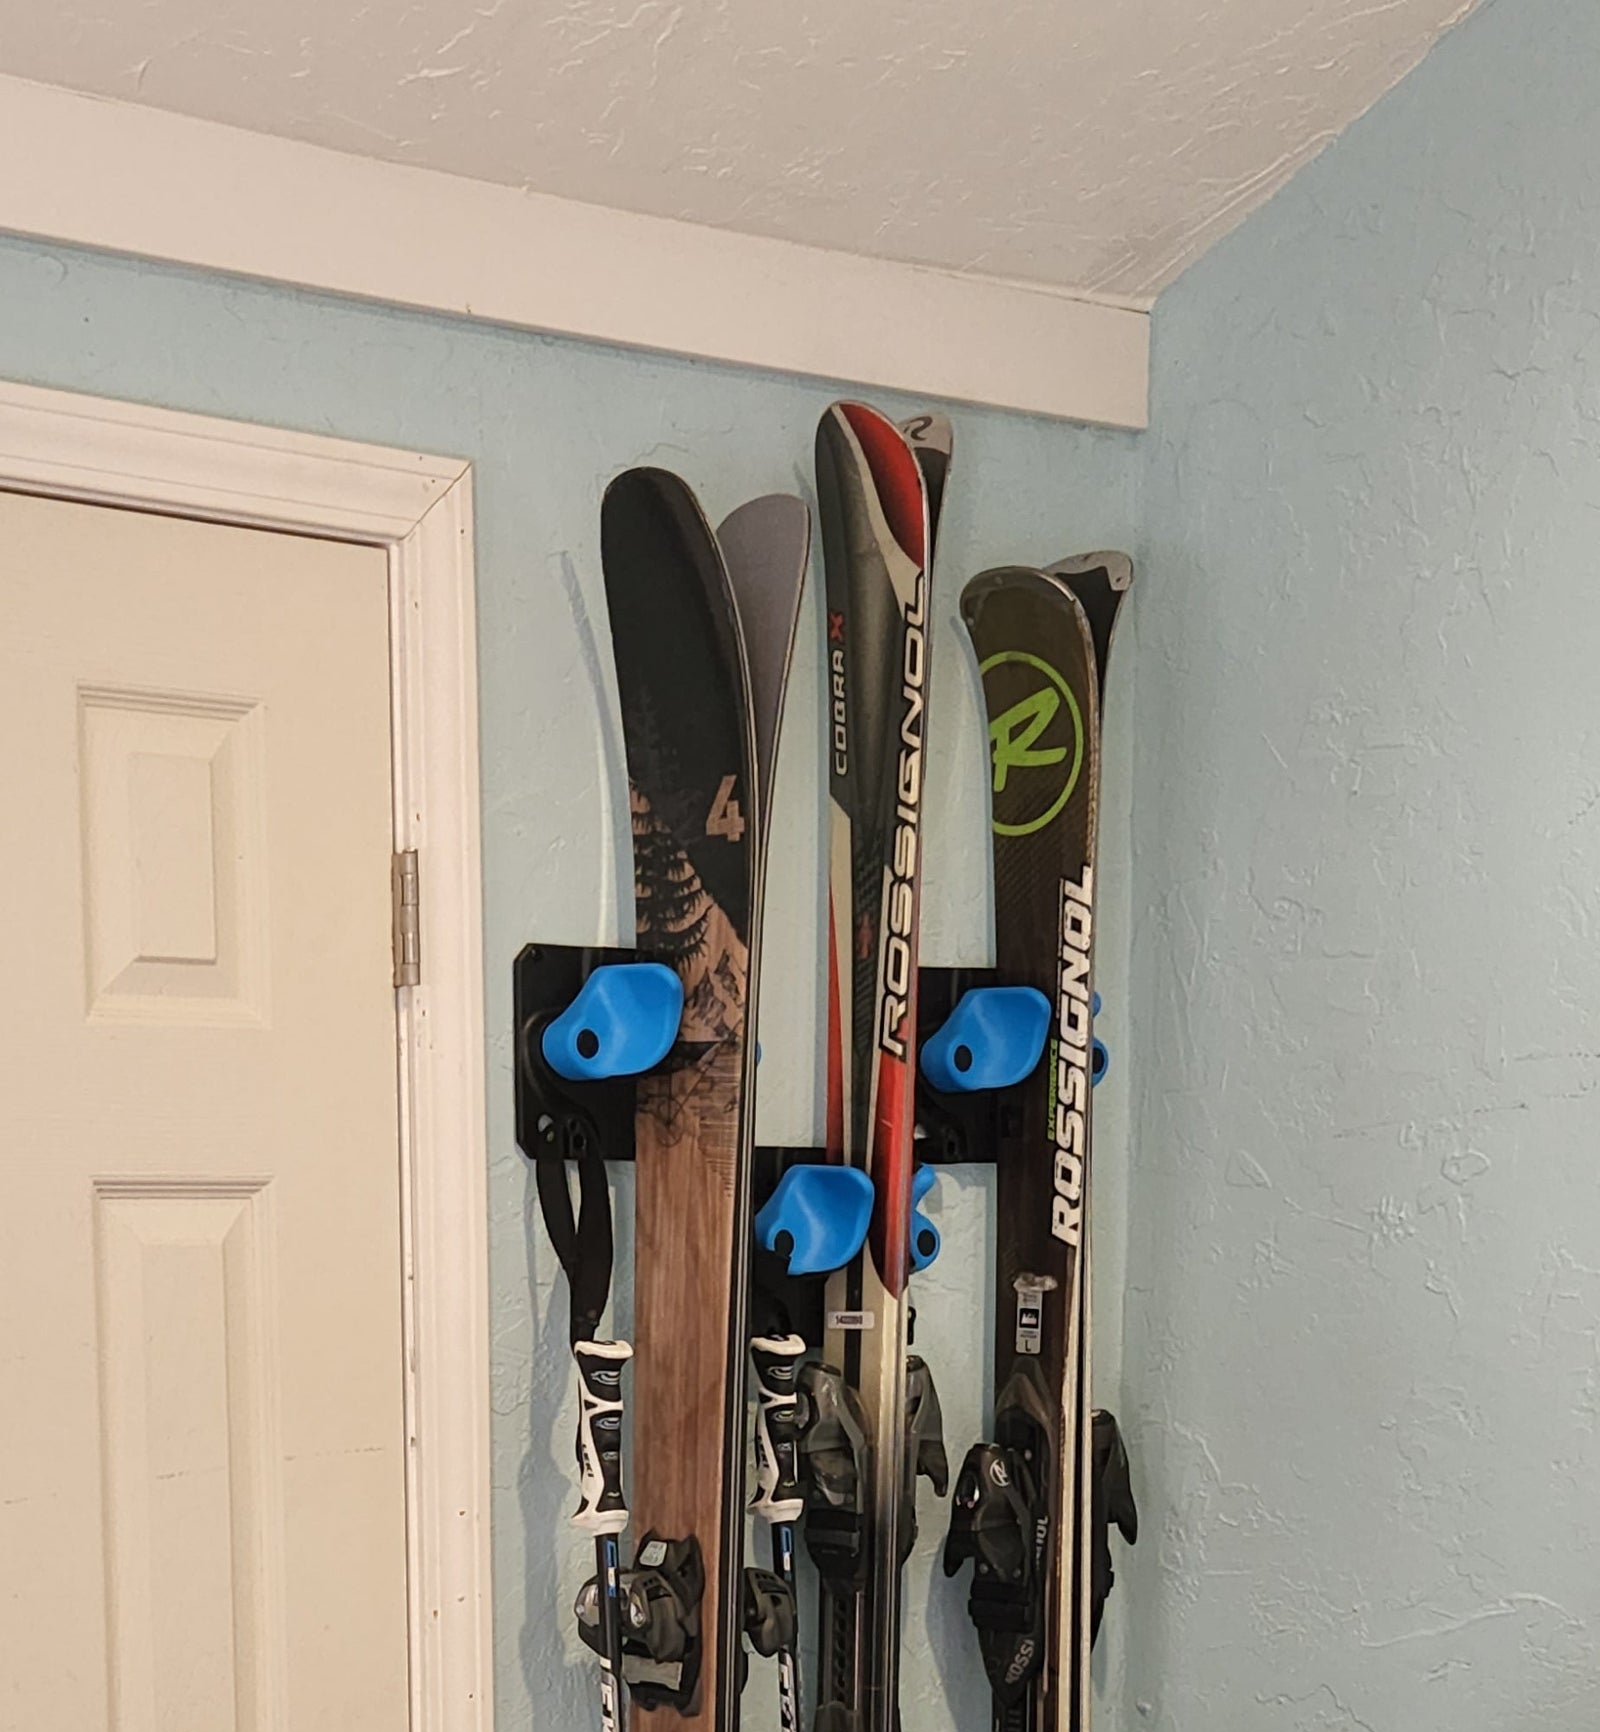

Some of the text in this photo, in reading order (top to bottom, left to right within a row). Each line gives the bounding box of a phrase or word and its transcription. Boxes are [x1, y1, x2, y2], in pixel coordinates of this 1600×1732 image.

[829, 609, 849, 777] COBRA X
[705, 774, 746, 843] 4
[878, 573, 927, 1058] ROSSIGNOL
[1047, 1037, 1060, 1142] EXPERIENCE
[1050, 864, 1094, 1247] ROSSIGNOL
